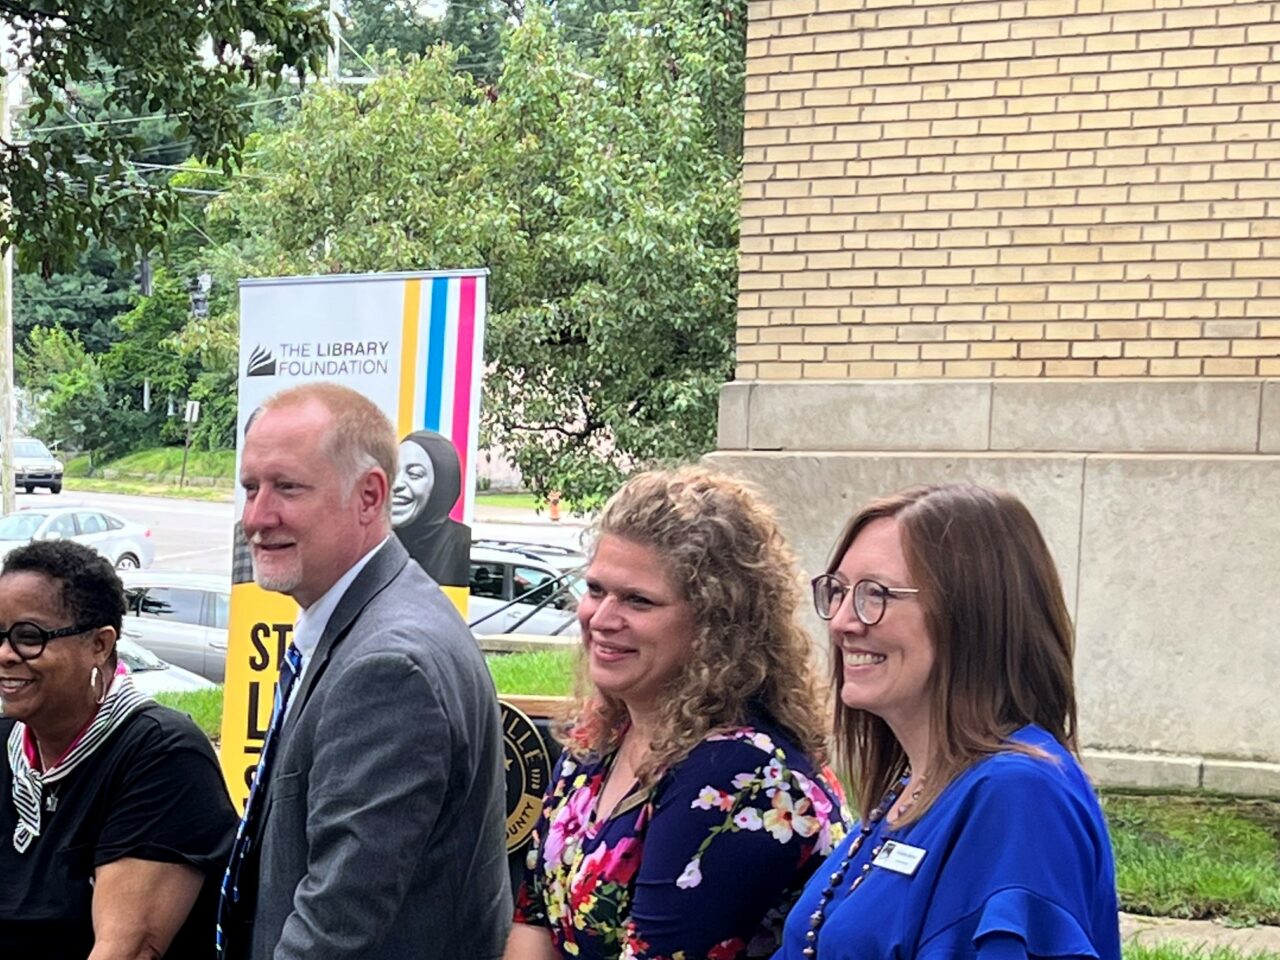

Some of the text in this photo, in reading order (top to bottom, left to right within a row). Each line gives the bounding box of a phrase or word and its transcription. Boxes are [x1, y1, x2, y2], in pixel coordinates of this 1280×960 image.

[280, 341, 389, 357] THE LIBRARY
[279, 359, 388, 377] FOUNDATION
